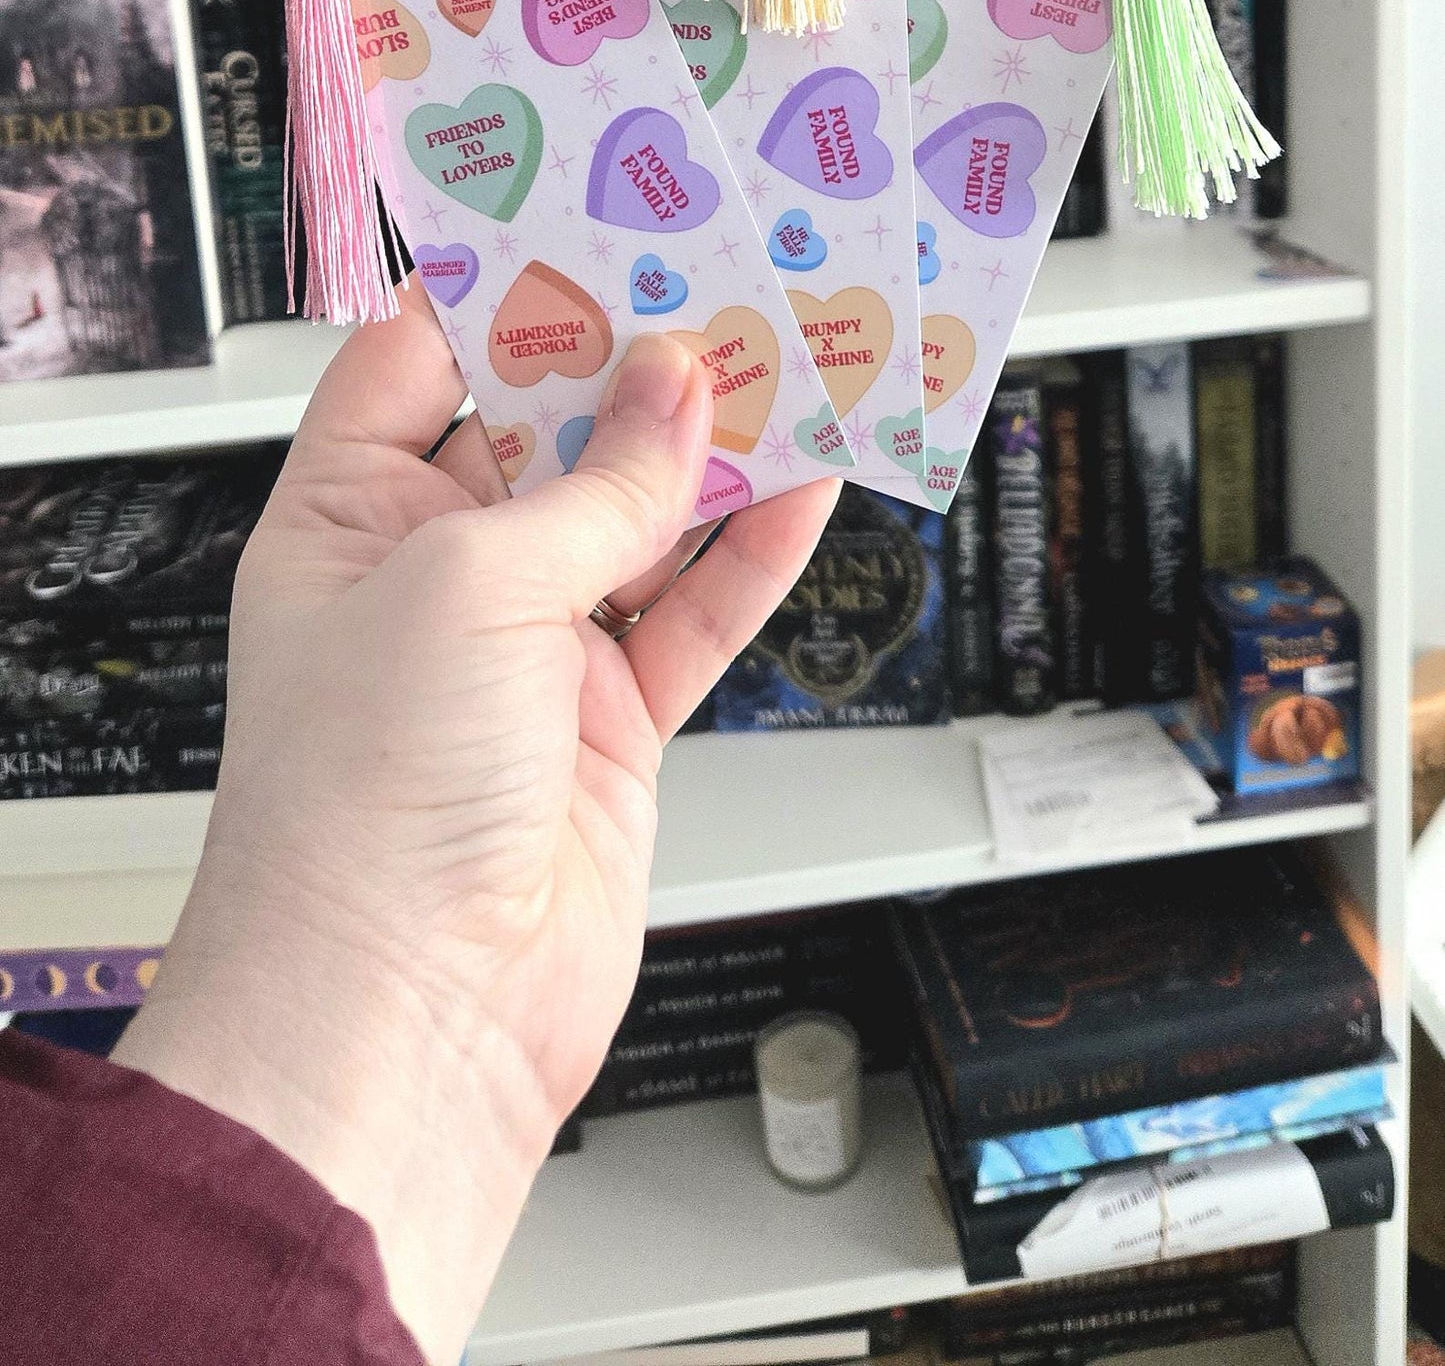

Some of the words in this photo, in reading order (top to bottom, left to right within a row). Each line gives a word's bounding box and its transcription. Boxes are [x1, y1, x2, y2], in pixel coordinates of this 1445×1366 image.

[452, 0, 492, 16] PARENT
[573, 4, 617, 36] BEST
[1029, 1, 1078, 28] BEST
[355, 9, 400, 36] BUR
[0, 104, 173, 148] EMISED
[424, 113, 506, 149] FRIENDS
[457, 139, 484, 160] TO
[807, 109, 842, 186] FAMILY
[828, 105, 861, 180] FOUND
[440, 151, 515, 186] LOVERS
[636, 143, 691, 212] FOUND
[963, 137, 990, 215] FAMILY
[984, 141, 1011, 216] FOUND
[619, 153, 676, 225] FAMILY
[775, 230, 799, 259] FIRST
[782, 224, 807, 257] FALLS
[795, 226, 810, 243] HE
[638, 271, 668, 298] FALLS
[650, 268, 667, 284] HE
[634, 280, 662, 304] FIRST
[495, 319, 586, 347] PROXIMITY
[803, 318, 862, 338] RUMPY
[509, 337, 578, 359] FORCED
[701, 337, 746, 368] UMPY
[813, 349, 875, 369] NSHINE
[711, 362, 770, 400] NSHINE
[493, 432, 520, 451] ONE
[812, 422, 839, 444] AGE
[819, 434, 845, 455] GAP
[892, 427, 921, 446] AGE
[497, 443, 525, 463] BED
[894, 440, 923, 458] GAP
[927, 477, 956, 492] GAP
[929, 464, 958, 479] AGE
[700, 482, 744, 506] ROYALTY
